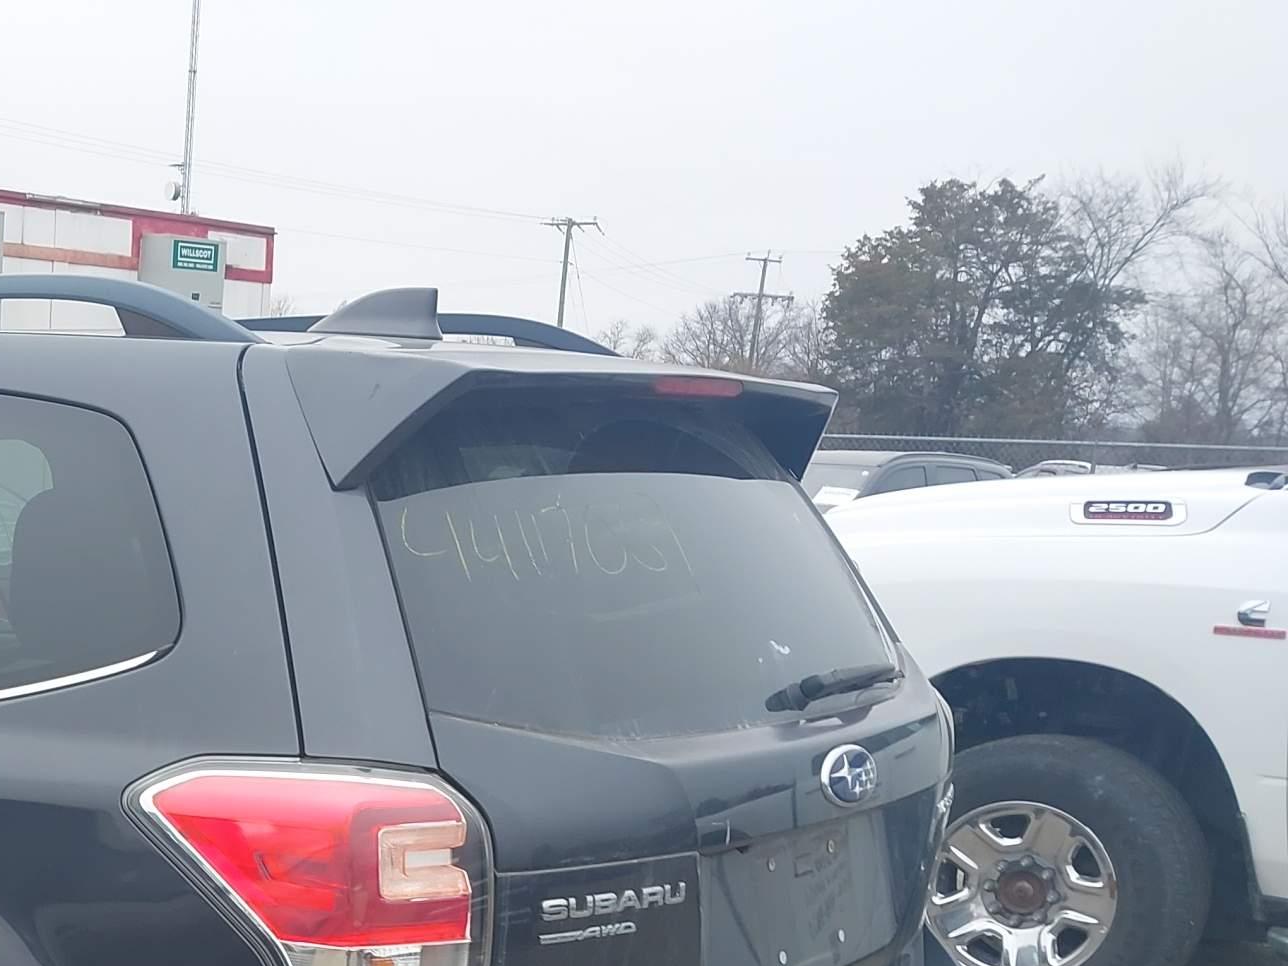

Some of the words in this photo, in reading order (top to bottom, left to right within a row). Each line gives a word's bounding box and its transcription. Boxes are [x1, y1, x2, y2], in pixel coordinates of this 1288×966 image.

[181, 247, 212, 259] WILLSCOT
[1088, 502, 1167, 513] 2500
[540, 881, 687, 922] SUBARU
[580, 921, 638, 941] AWD
